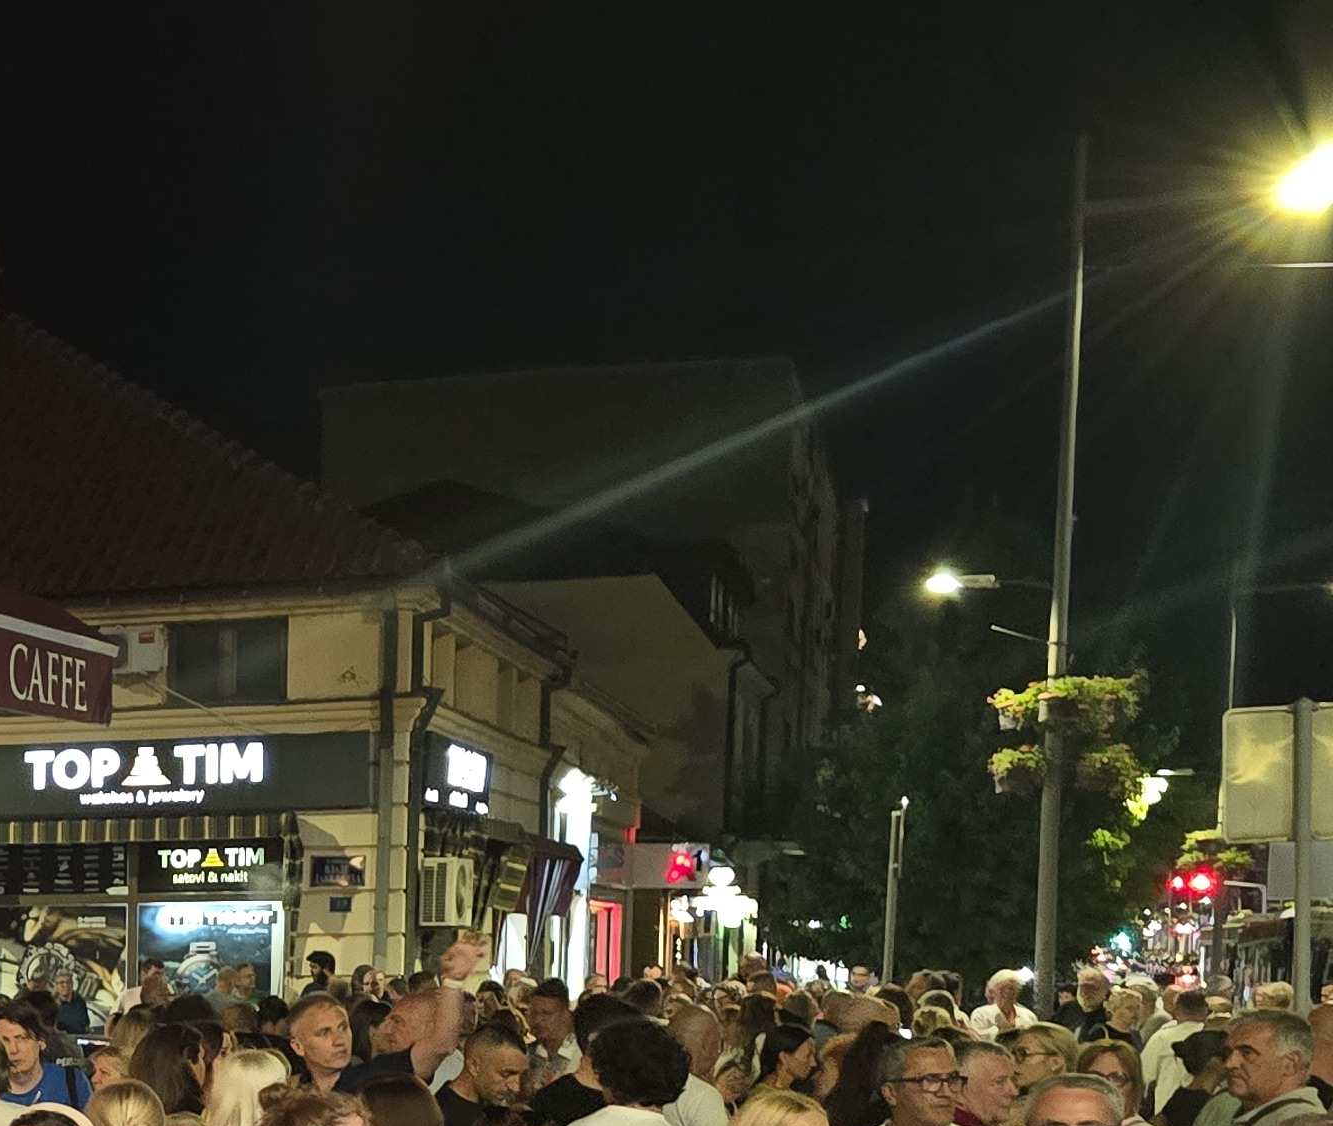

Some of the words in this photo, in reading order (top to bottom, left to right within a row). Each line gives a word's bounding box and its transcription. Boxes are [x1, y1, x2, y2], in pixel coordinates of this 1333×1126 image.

[9, 643, 89, 712] CAFFE
[24, 748, 121, 790] TOP
[173, 741, 264, 785] TIM
[158, 849, 201, 869] TOP
[225, 847, 265, 867] TIM
